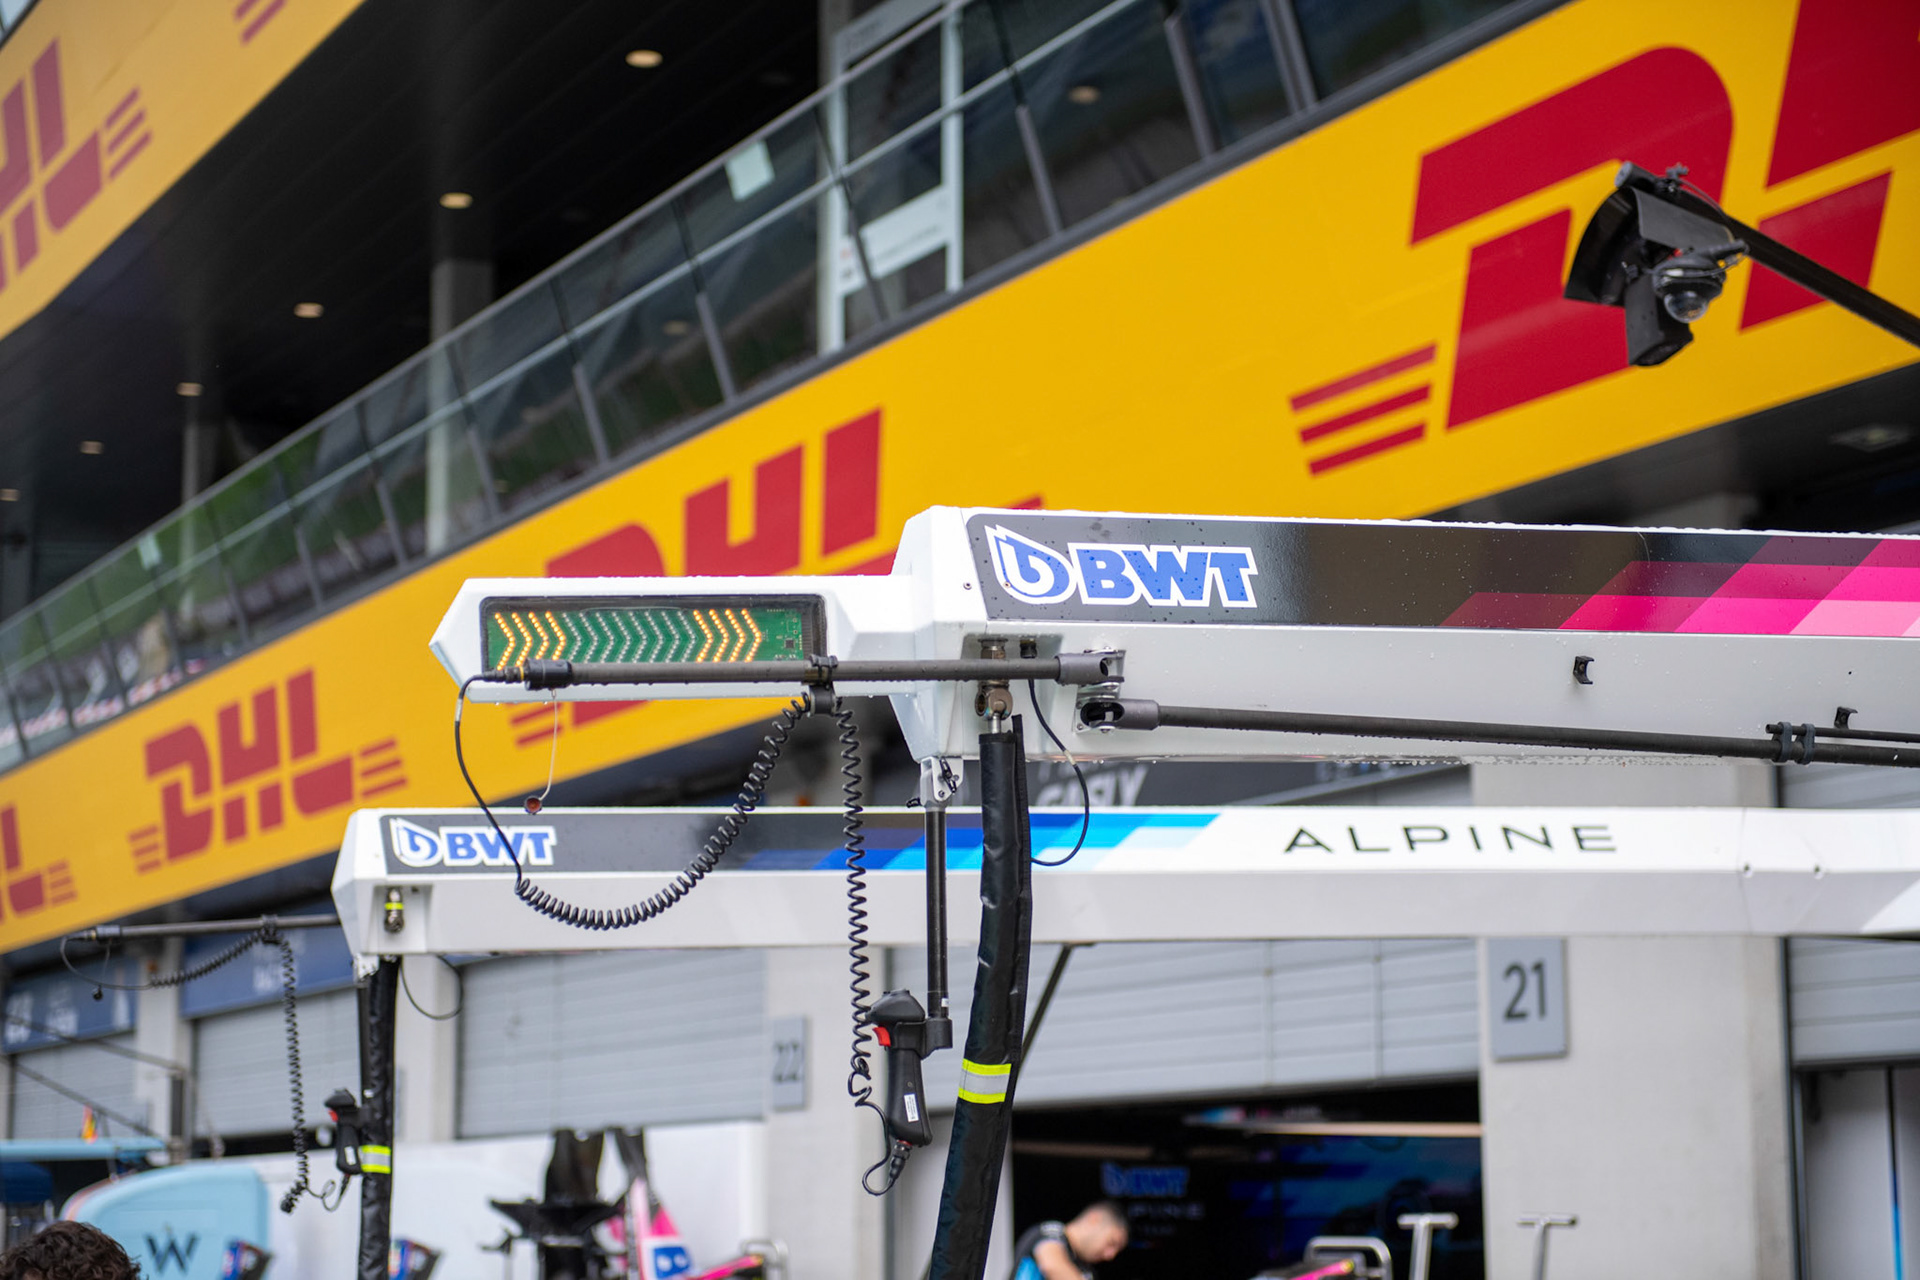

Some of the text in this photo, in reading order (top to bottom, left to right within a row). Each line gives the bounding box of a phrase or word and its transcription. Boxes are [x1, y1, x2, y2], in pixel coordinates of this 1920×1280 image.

[1069, 543, 1257, 607] BWT
[143, 667, 353, 862] DHL
[441, 825, 556, 866] BWT
[1284, 825, 1618, 853] ALPINE
[1502, 958, 1549, 1021] 21
